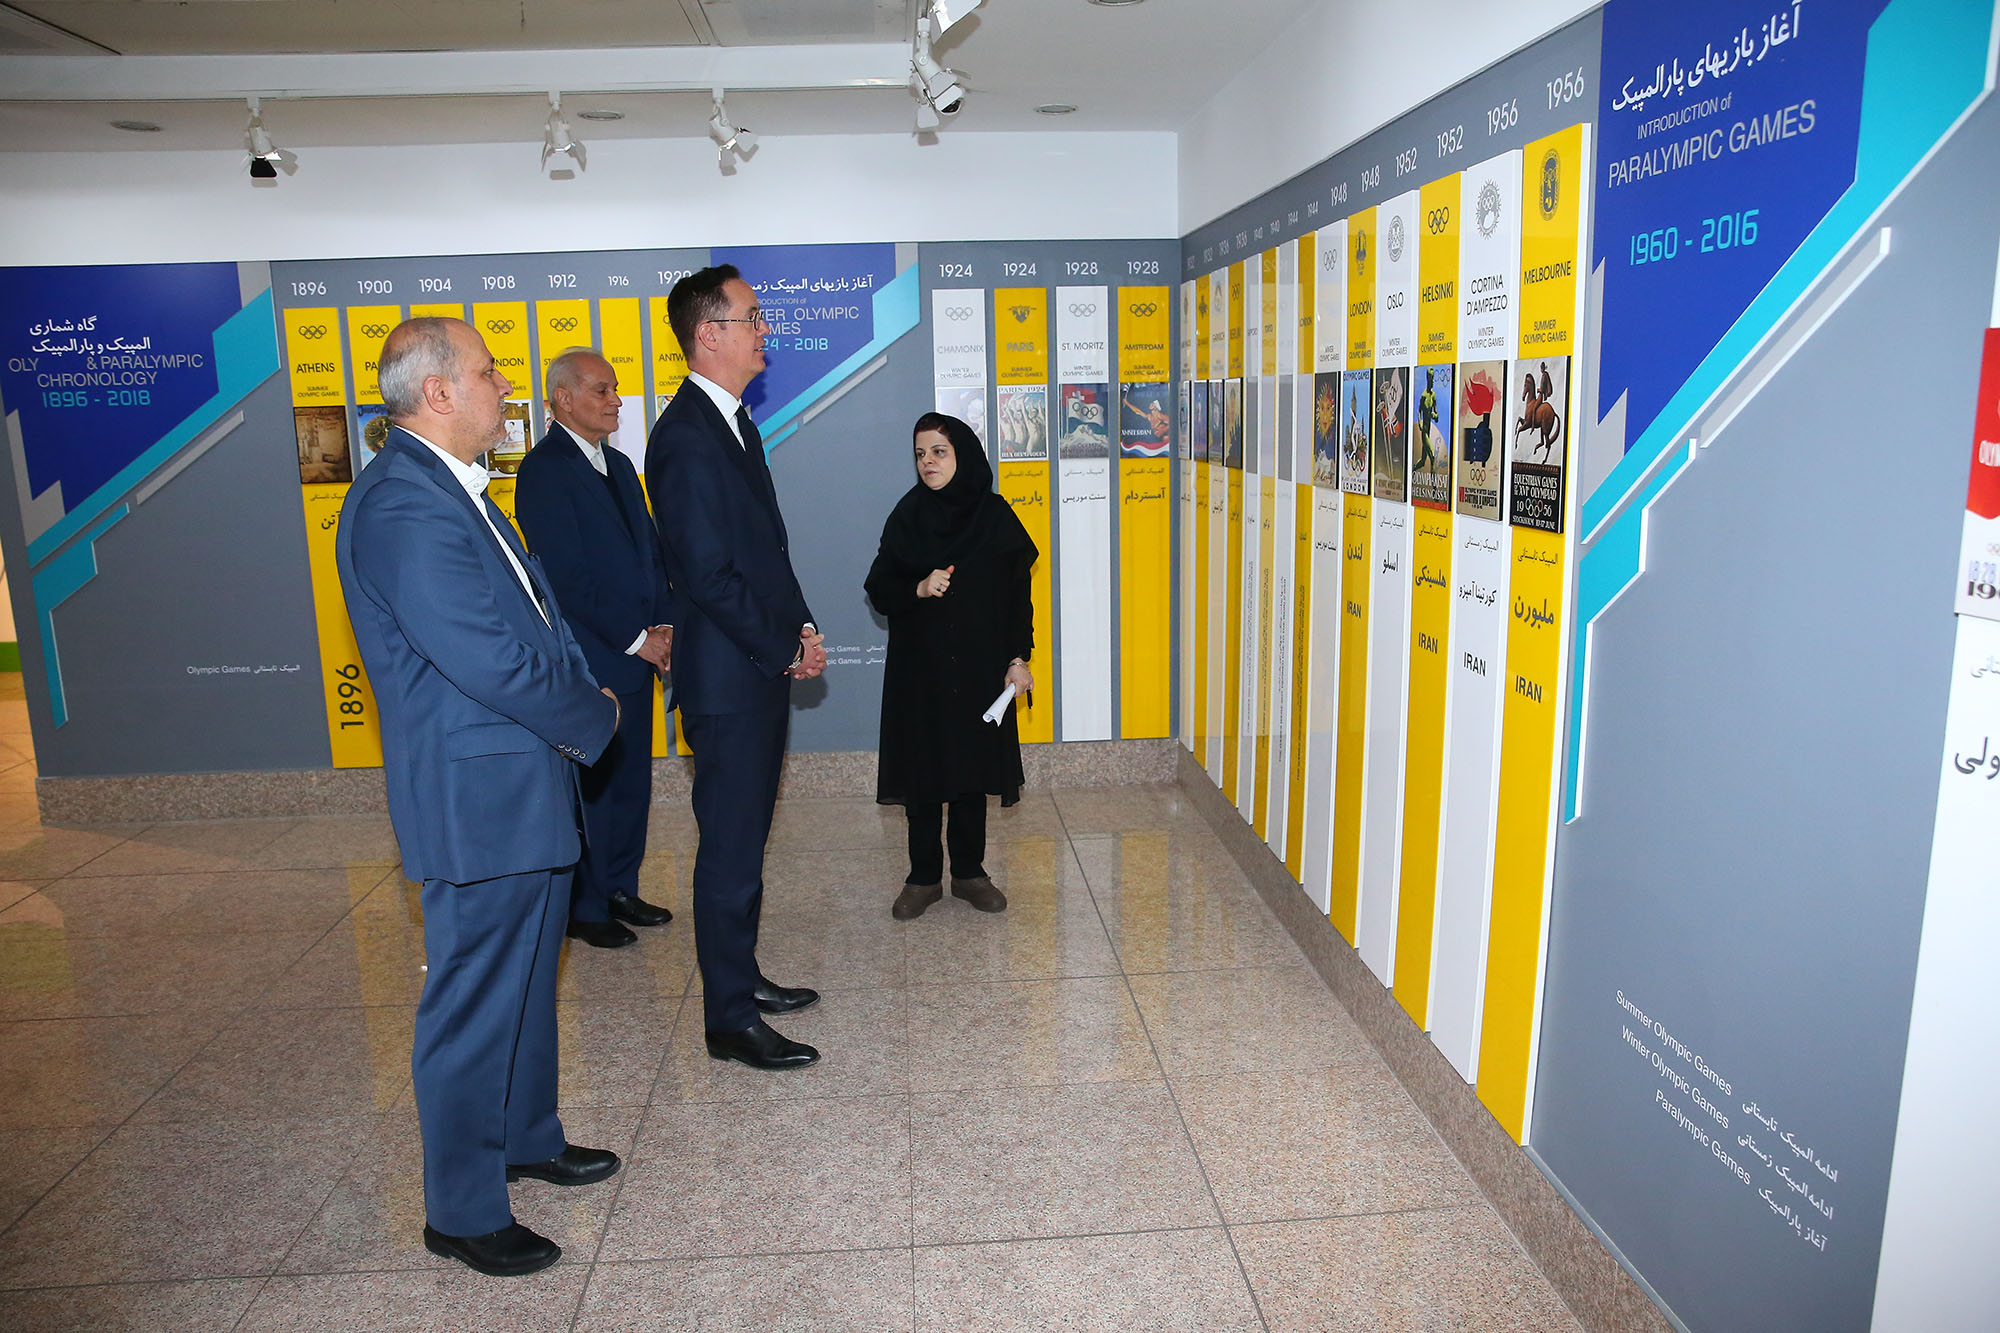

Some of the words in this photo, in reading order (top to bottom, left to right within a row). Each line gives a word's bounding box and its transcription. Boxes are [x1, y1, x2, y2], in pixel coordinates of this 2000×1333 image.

[1756, 0, 1801, 61] آغاز
[1687, 27, 1754, 87] بازیهای
[1547, 66, 1585, 110] 1956
[1611, 58, 1685, 112] پارالمپیک
[1487, 98, 1518, 136] 1956
[1637, 97, 1718, 140] INTRODUCTION
[1720, 92, 1732, 112] of
[1437, 125, 1464, 158] 1952
[1608, 129, 1723, 188] PARALYMPIC
[1729, 99, 1816, 153] GAMES
[1396, 147, 1417, 178] 1952
[1361, 165, 1380, 193] 1948
[1331, 182, 1348, 207] 1948
[1630, 226, 1678, 266] 1960
[1701, 209, 1759, 253] 2016
[939, 263, 973, 277] 1924
[1003, 262, 1037, 276] 1924
[1065, 262, 1098, 276] 1928
[1127, 261, 1159, 275] 1928
[1524, 260, 1571, 285] MELBOURNE
[291, 282, 327, 296] 1896
[357, 280, 393, 294] 1900
[419, 278, 453, 293] 1904
[482, 276, 516, 290] 1908
[548, 274, 577, 288] 1912
[608, 275, 630, 287] 1916
[770, 278, 808, 294] المپیک
[810, 277, 849, 292] بازیهای
[851, 274, 873, 290] آغاز
[1471, 274, 1504, 295] CORTINA
[1387, 292, 1404, 311] OSLO
[1422, 281, 1454, 303] HELSINKI
[793, 306, 860, 320] OLYMPIC
[1350, 300, 1372, 318] LONDON
[1466, 294, 1508, 316] D'AMPEZZO
[29, 318, 75, 336] شماری
[77, 315, 97, 332] گاه
[769, 321, 801, 335] MES
[1478, 326, 1494, 337] WINTER
[1534, 319, 1556, 331] SUMMER
[32, 338, 94, 356] پارالمپیک
[106, 336, 151, 355] المپیک
[761, 338, 779, 351] 24
[794, 337, 829, 351] 2018
[1007, 342, 1035, 352] PARIS
[1074, 342, 1104, 350] MORITZ
[1468, 338, 1488, 350] OLYMPIC
[1488, 336, 1505, 348] GAMES
[1523, 333, 1546, 344] OLYMPIC
[1547, 331, 1567, 342] GAMES
[96, 345, 104, 355] و
[659, 353, 684, 361] ANTW
[937, 345, 984, 354] CHAMONIX
[8, 357, 39, 373] OLY
[86, 356, 98, 371] &
[101, 354, 204, 370] PARALYMPIC
[296, 362, 335, 373] ATHENS
[494, 357, 524, 367] NDON
[37, 371, 158, 388] CHRONOLOGY
[42, 391, 88, 408] 1896
[107, 390, 151, 407] 2018
[1347, 543, 1363, 560] لندن
[1382, 550, 1398, 574] اسلو
[1415, 565, 1447, 588] هلسینکی
[1347, 600, 1361, 618] IRAN
[1514, 595, 1554, 629] ملبورن
[1418, 632, 1438, 654] IRAN
[187, 666, 220, 675] Olympic
[221, 665, 251, 673] Games
[1463, 651, 1486, 677] IRAN
[335, 664, 364, 730] 1896
[1515, 675, 1542, 703] IRAN
[1616, 989, 1653, 1028] Summer
[1654, 1022, 1692, 1062] Olympic
[1694, 1056, 1732, 1096] Games
[1622, 1025, 1650, 1060] Winter
[1651, 1052, 1689, 1094] Olympic
[1691, 1087, 1729, 1129] Games
[1742, 1102, 1778, 1131] تابستانی
[1655, 1089, 1709, 1147] Paralympic
[1711, 1141, 1751, 1185] Games
[1780, 1131, 1814, 1162] المپیک
[1737, 1134, 1772, 1167] زمستانی
[1815, 1159, 1838, 1183] ادامه
[1776, 1165, 1808, 1198] المپیک
[1759, 1187, 1802, 1236] پارالمپیک
[1809, 1194, 1833, 1220] ادامه
[1804, 1227, 1828, 1251] آغاز
